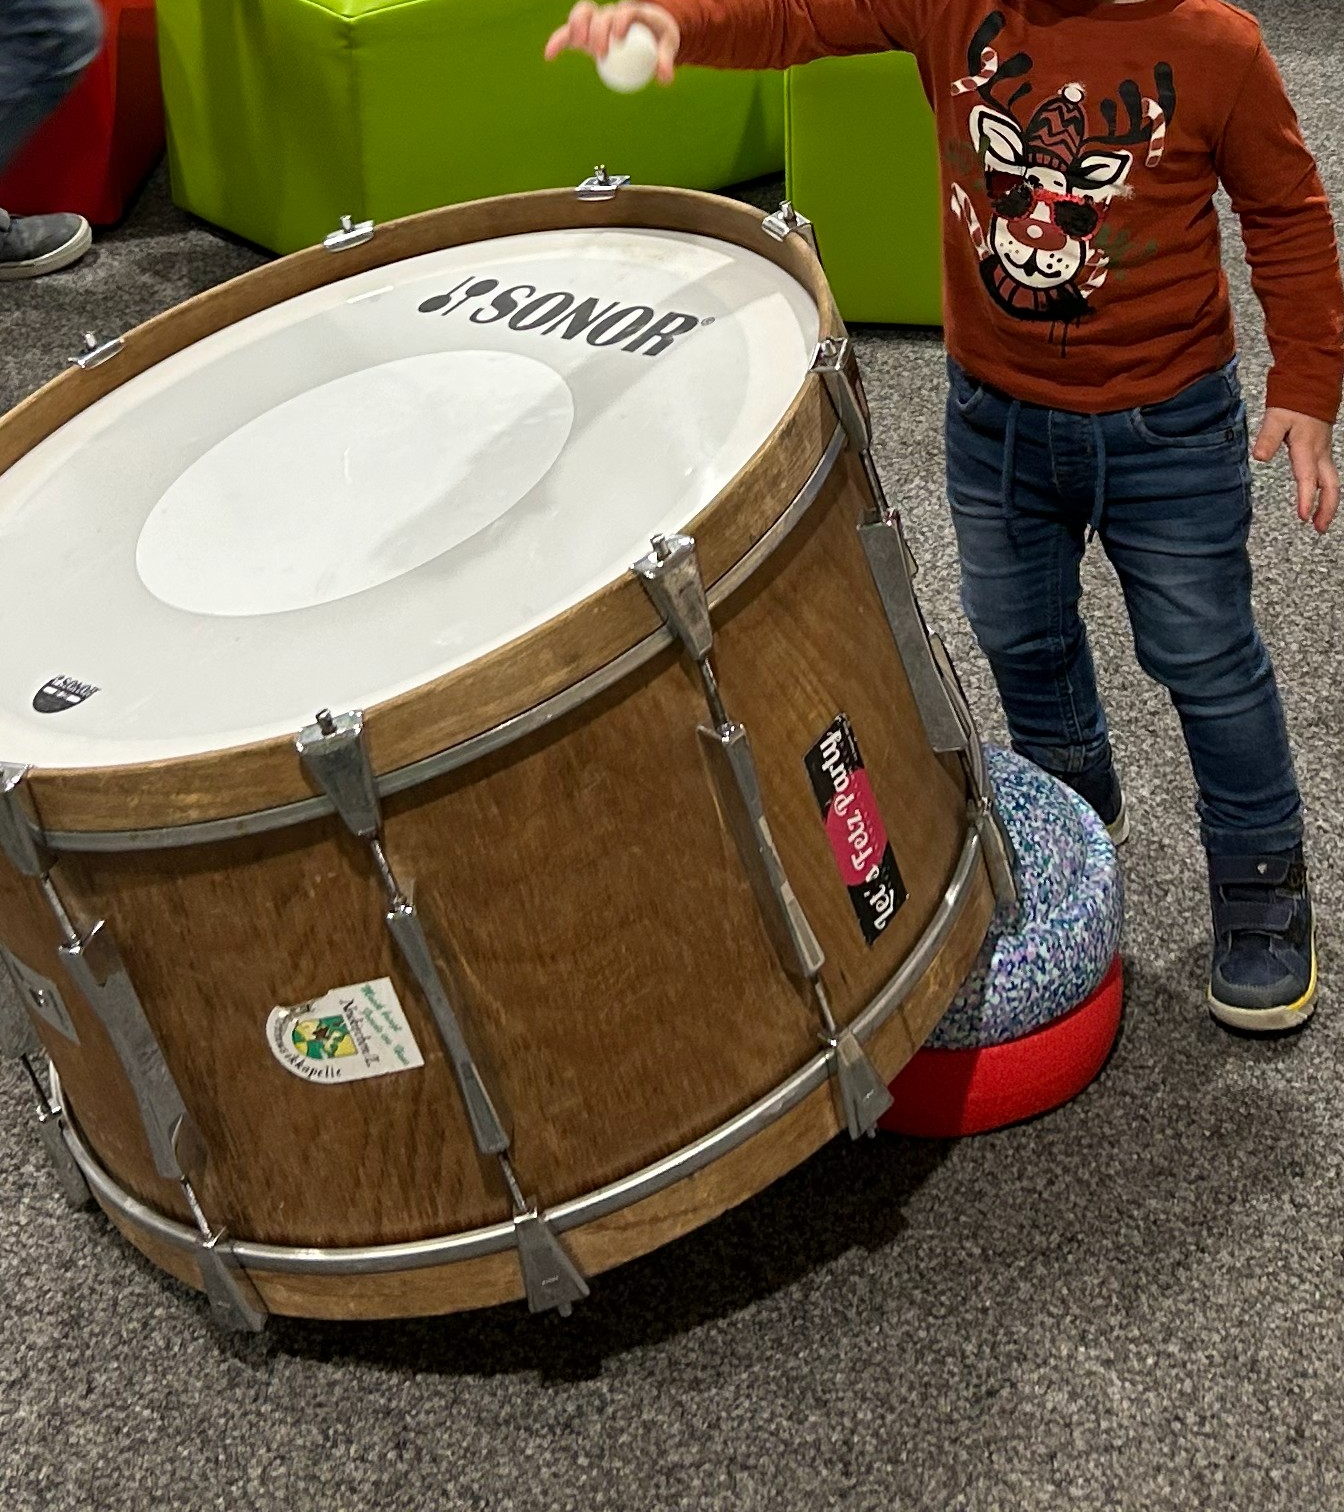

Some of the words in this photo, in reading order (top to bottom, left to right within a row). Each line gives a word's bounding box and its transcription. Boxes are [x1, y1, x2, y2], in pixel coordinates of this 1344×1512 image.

[469, 283, 700, 357] SONOR
[819, 727, 856, 817] Party
[846, 808, 874, 872] Fetz
[864, 864, 895, 931] Let's
